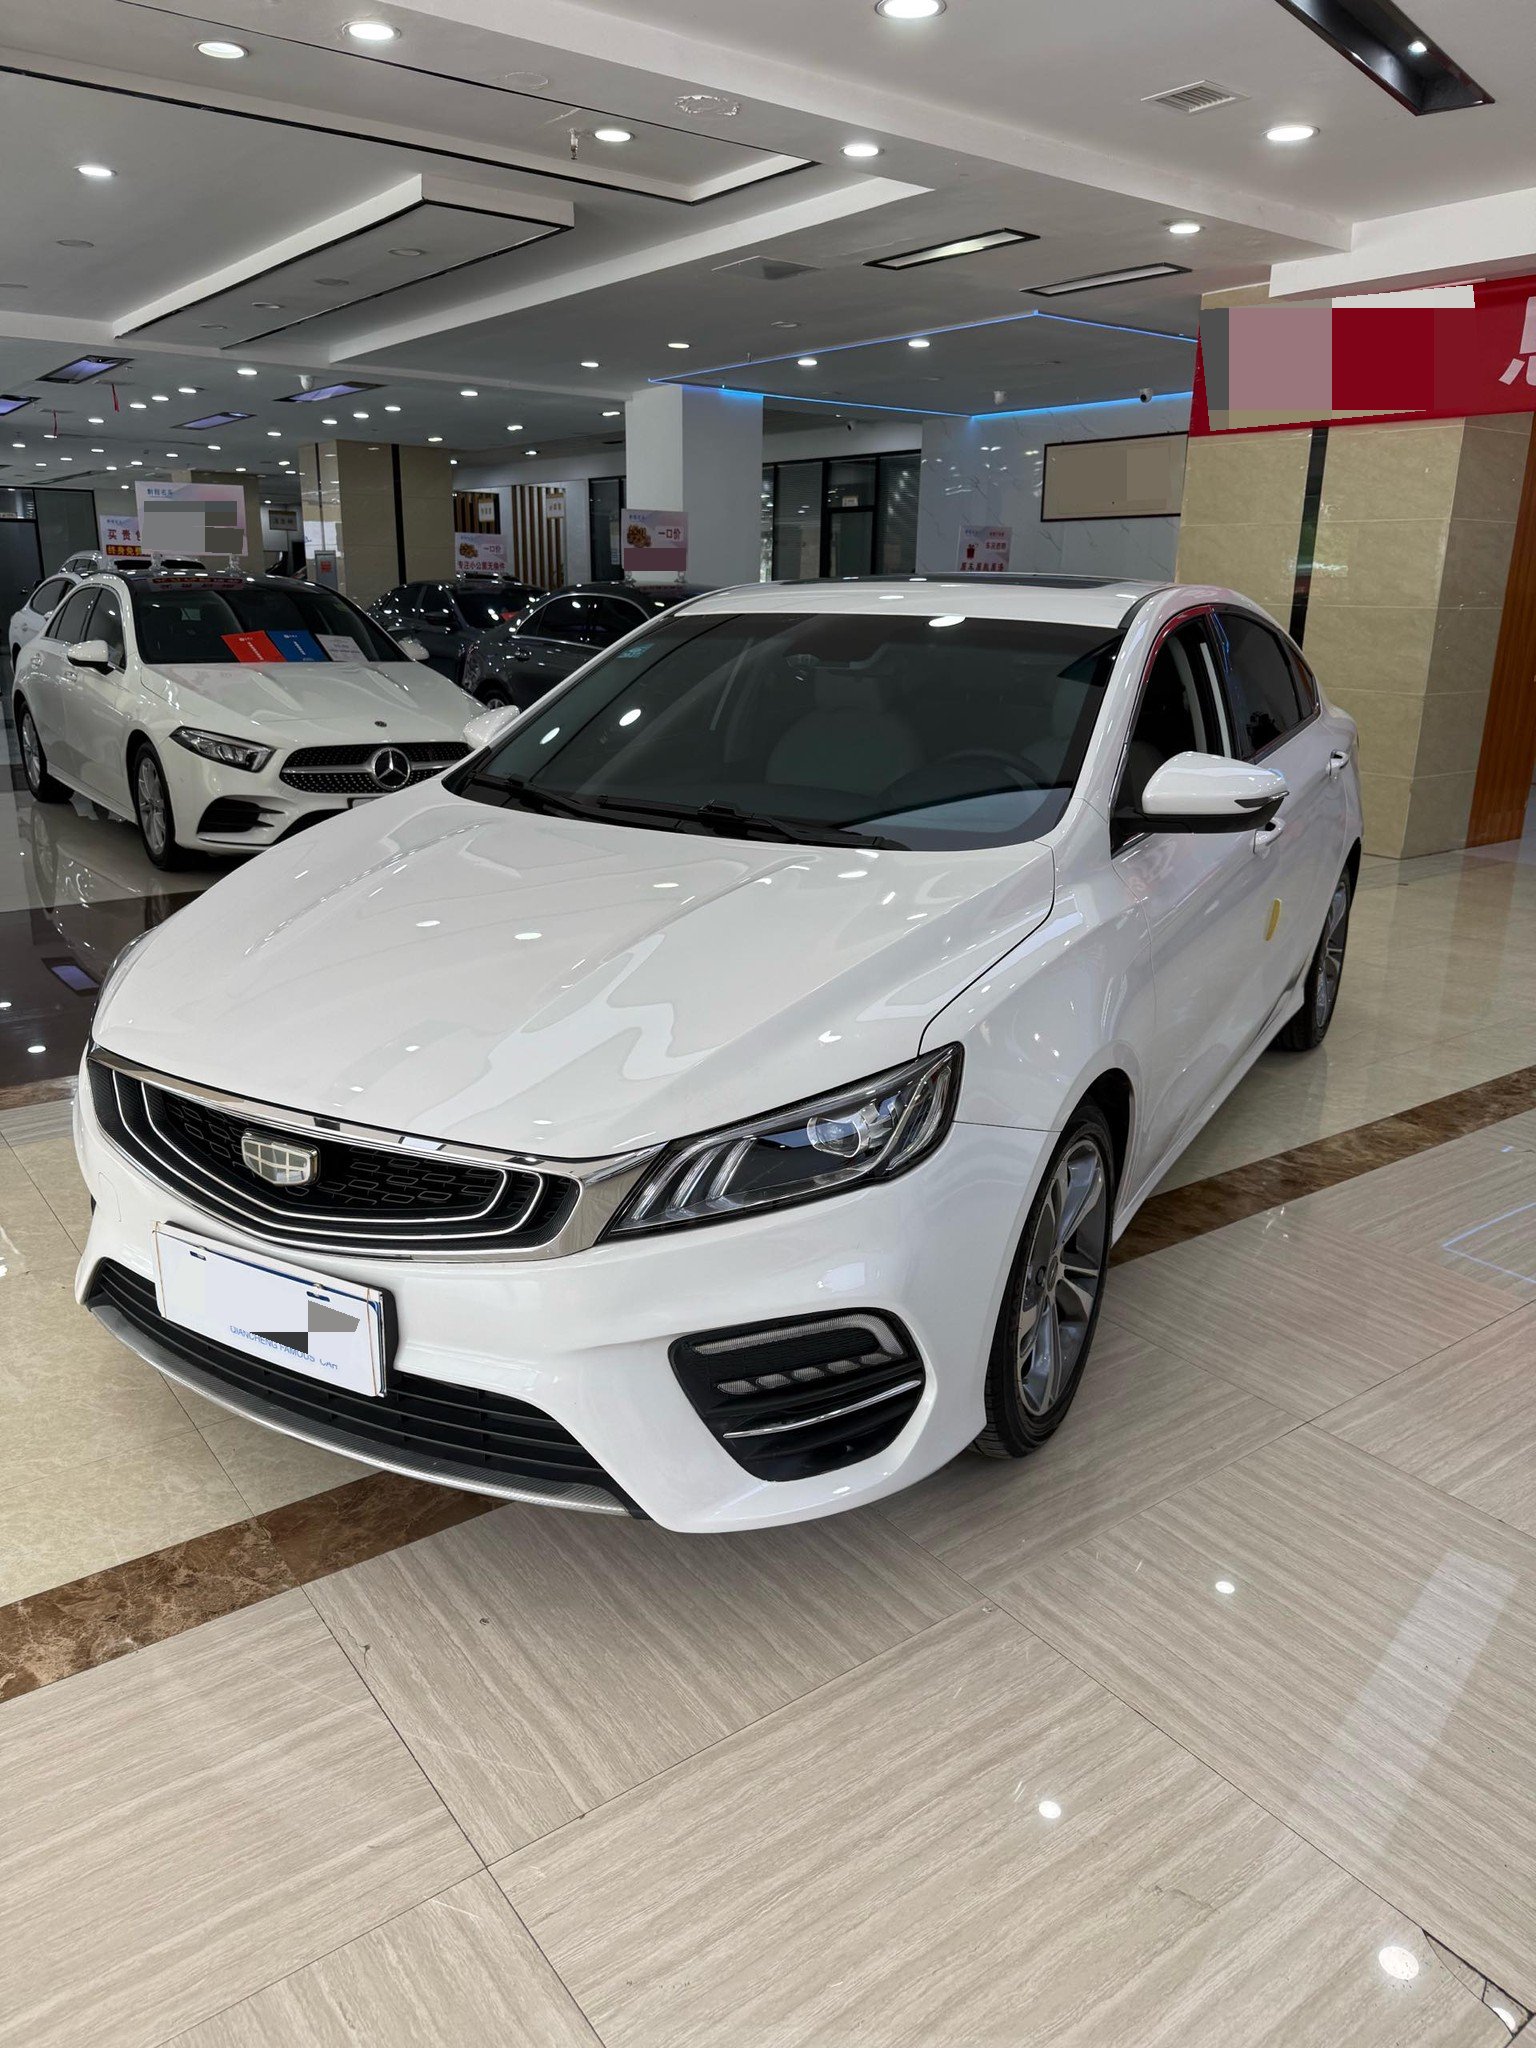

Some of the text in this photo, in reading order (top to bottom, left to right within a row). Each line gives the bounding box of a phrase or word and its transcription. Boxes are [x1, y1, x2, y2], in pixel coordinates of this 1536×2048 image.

[658, 528, 681, 540] 一口价
[279, 1343, 316, 1362] FAMOUS
